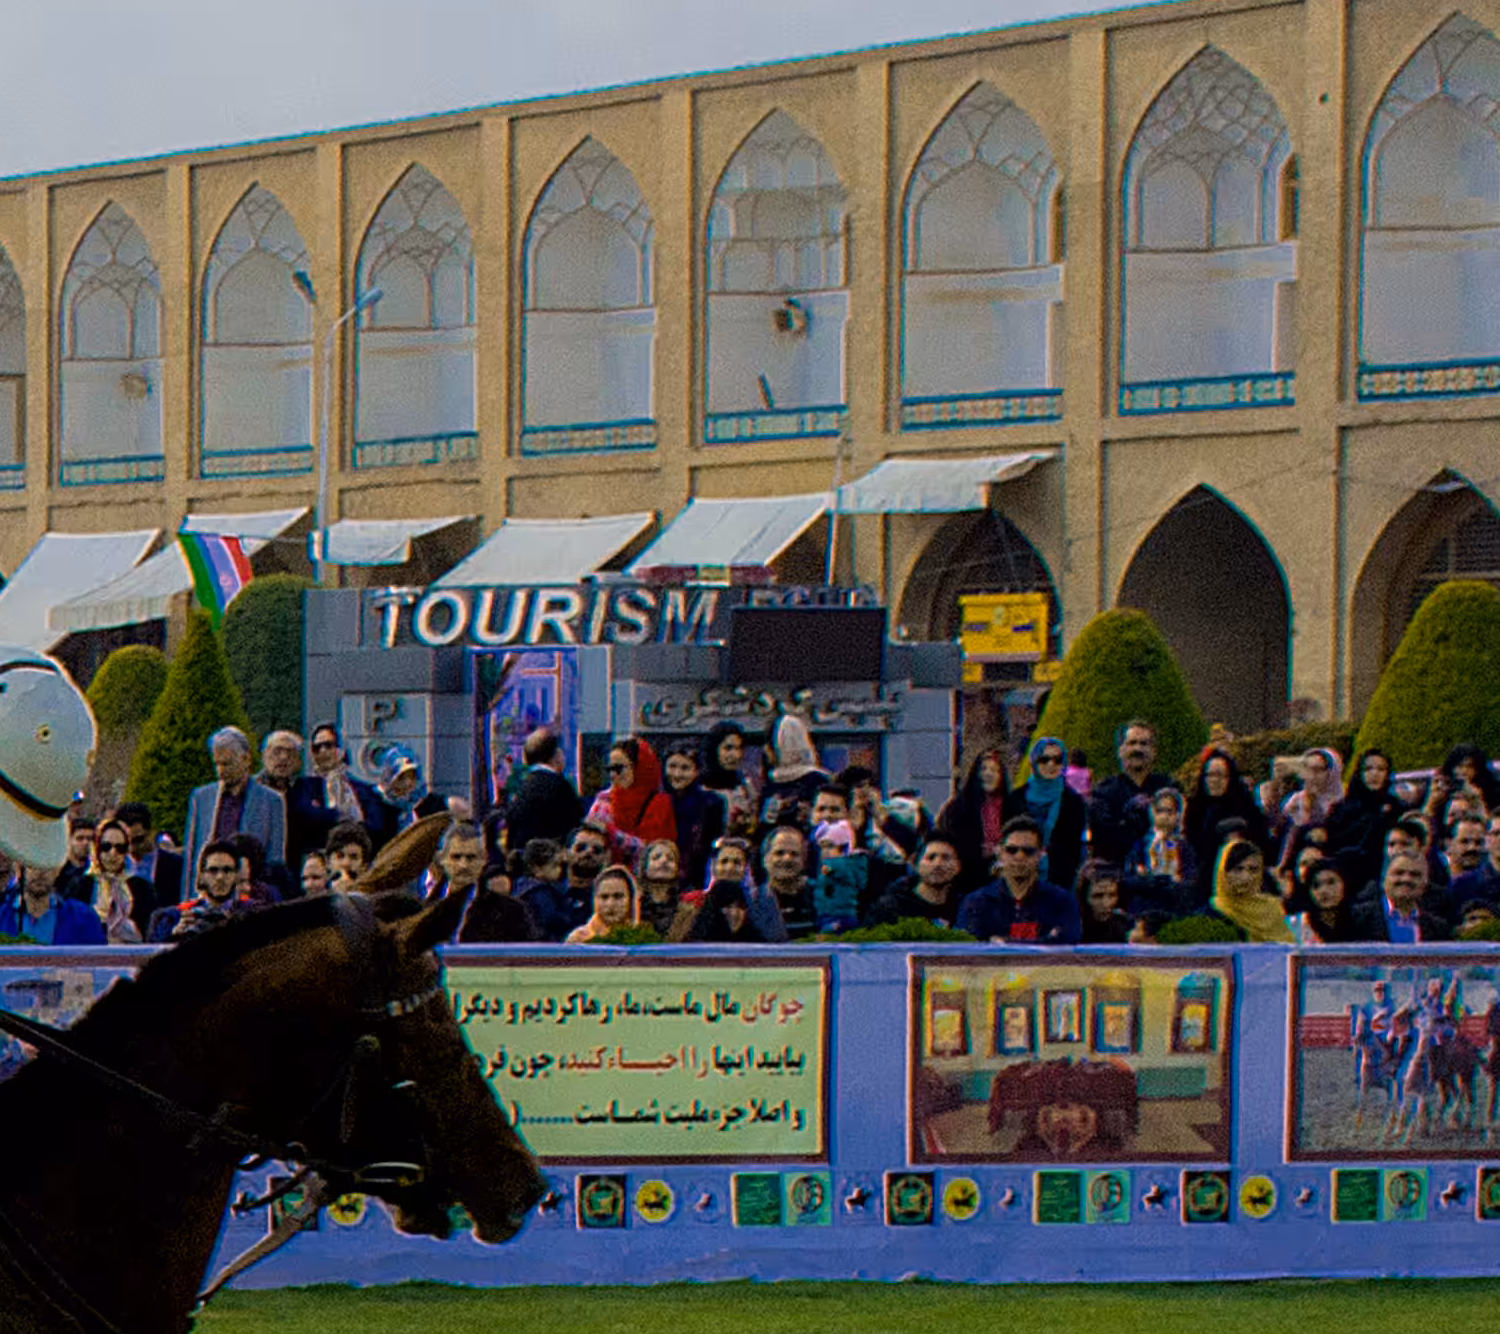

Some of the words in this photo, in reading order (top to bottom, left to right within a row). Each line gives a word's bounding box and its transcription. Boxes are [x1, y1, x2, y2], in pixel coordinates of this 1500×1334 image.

[370, 586, 726, 650] TOURISM
[452, 991, 505, 1024] دیگرا
[704, 991, 740, 1024] مال
[739, 992, 805, 1024] چوگان
[510, 1052, 555, 1080] چون
[689, 1045, 709, 1078] را
[710, 1045, 756, 1076] اینها
[662, 1099, 711, 1130] ملیت
[709, 1103, 749, 1131] جزء
[749, 1099, 791, 1123] اصلا
[791, 1107, 808, 1132] و
